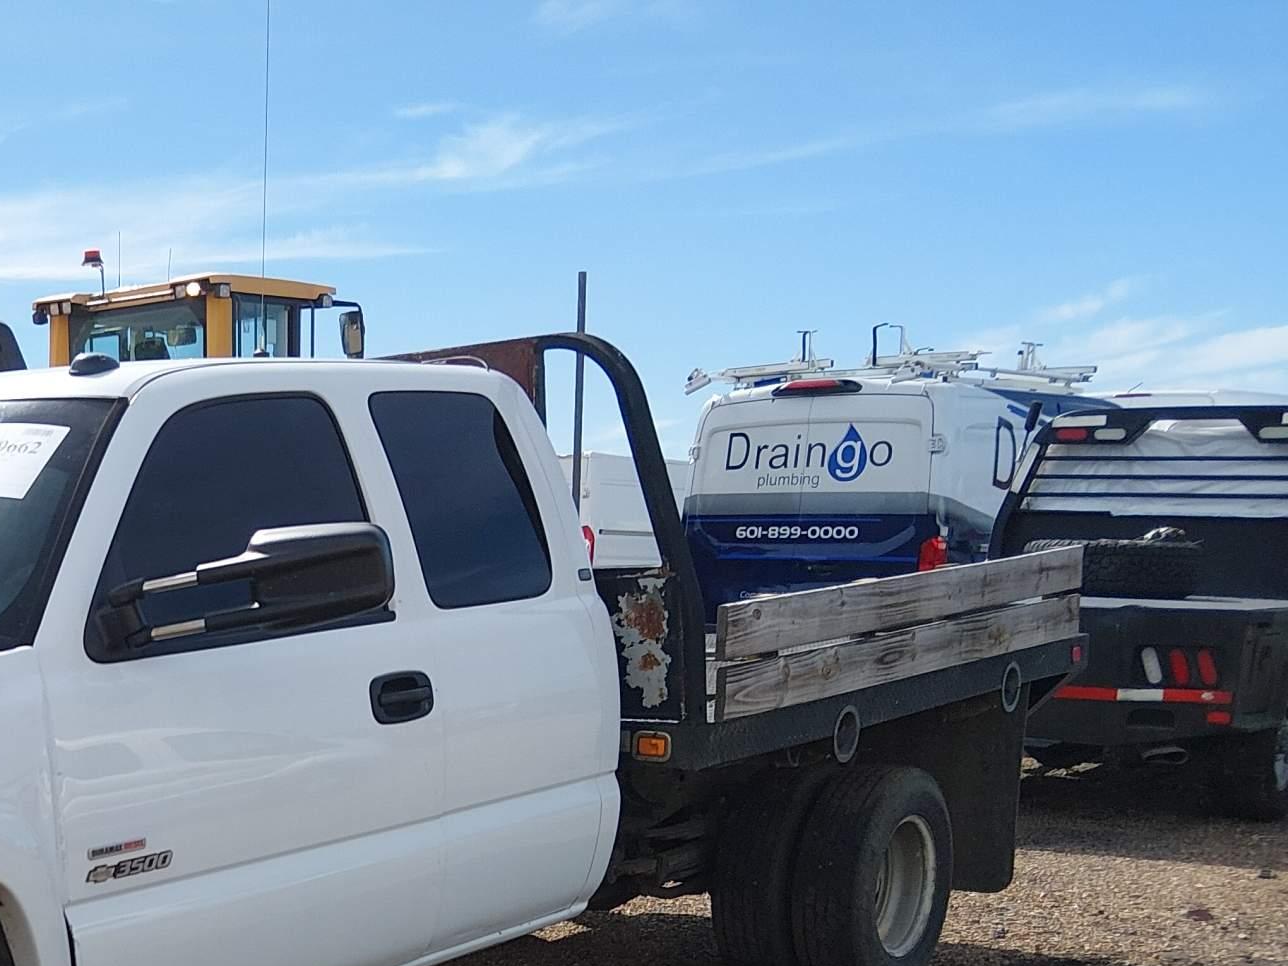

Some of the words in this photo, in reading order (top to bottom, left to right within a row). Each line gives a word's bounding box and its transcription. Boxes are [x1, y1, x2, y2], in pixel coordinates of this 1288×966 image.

[725, 432, 893, 478] Draingo
[757, 473, 820, 489] plumbing
[735, 525, 859, 539] 601-899-0000
[114, 850, 173, 878] 3500
